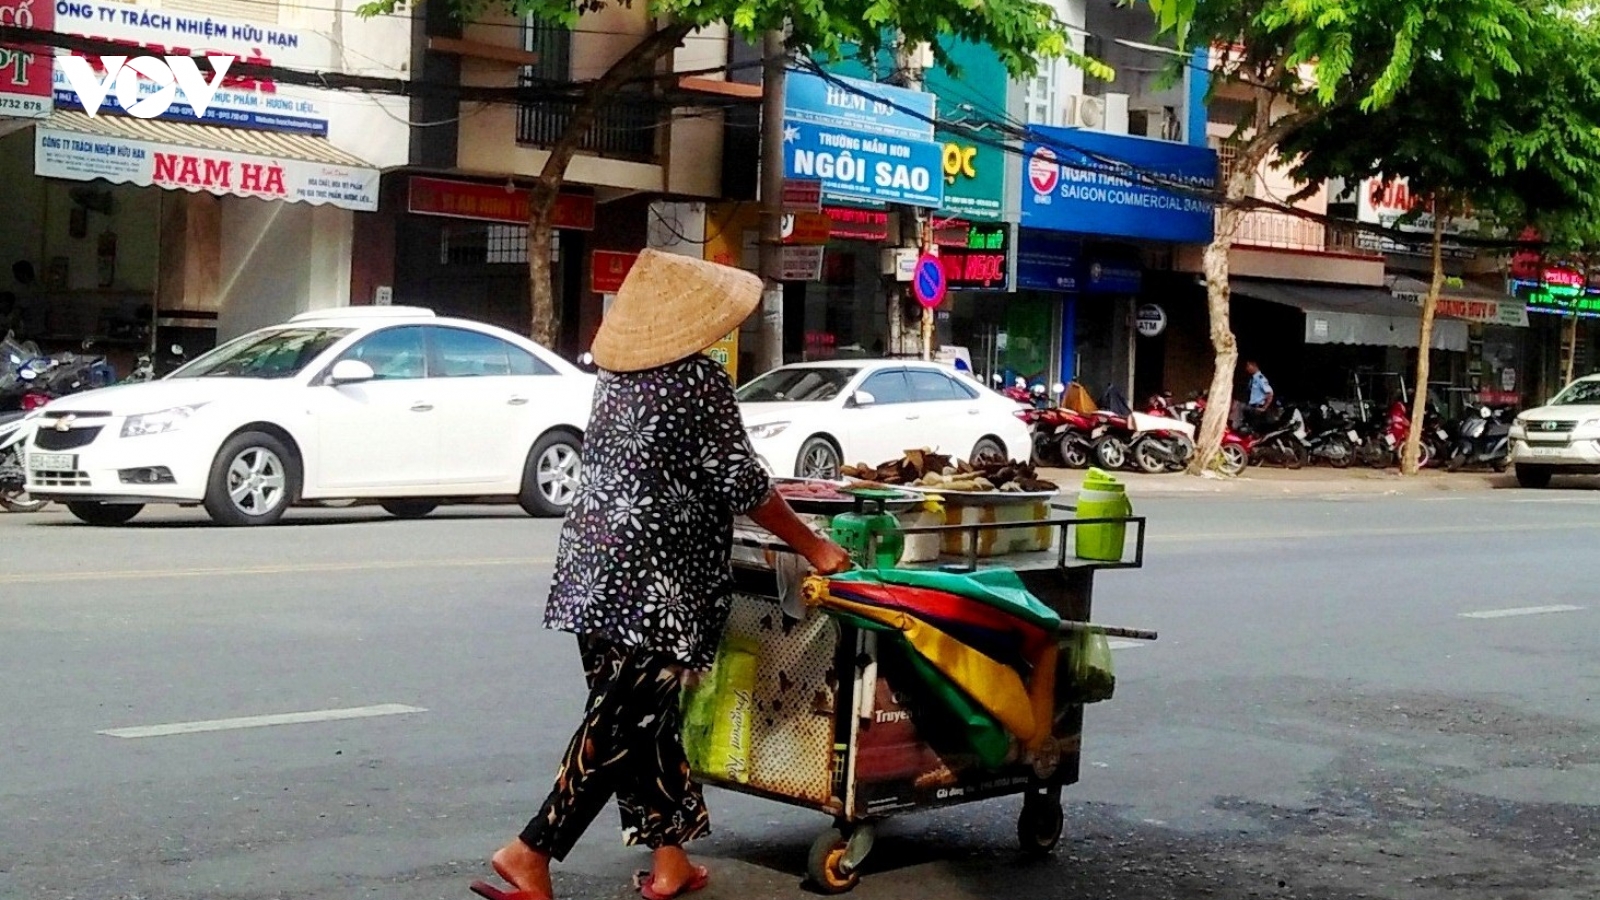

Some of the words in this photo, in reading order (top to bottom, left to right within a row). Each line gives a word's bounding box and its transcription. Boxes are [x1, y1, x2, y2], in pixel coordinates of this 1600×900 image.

[98, 7, 116, 22] TY
[121, 9, 171, 31] TRÁCH
[176, 17, 227, 41] NHIỆM
[232, 24, 263, 43] HỮU
[267, 30, 298, 50] HẠN
[24, 101, 42, 111] 878
[152, 152, 232, 188] NAM
[240, 161, 286, 194] HÀ
[794, 149, 866, 184] NGÔI
[875, 161, 930, 192] SAO
[1060, 184, 1106, 203] SAIGON
[1107, 187, 1182, 210] COMMERCIAL
[1138, 321, 1157, 330] ATM
